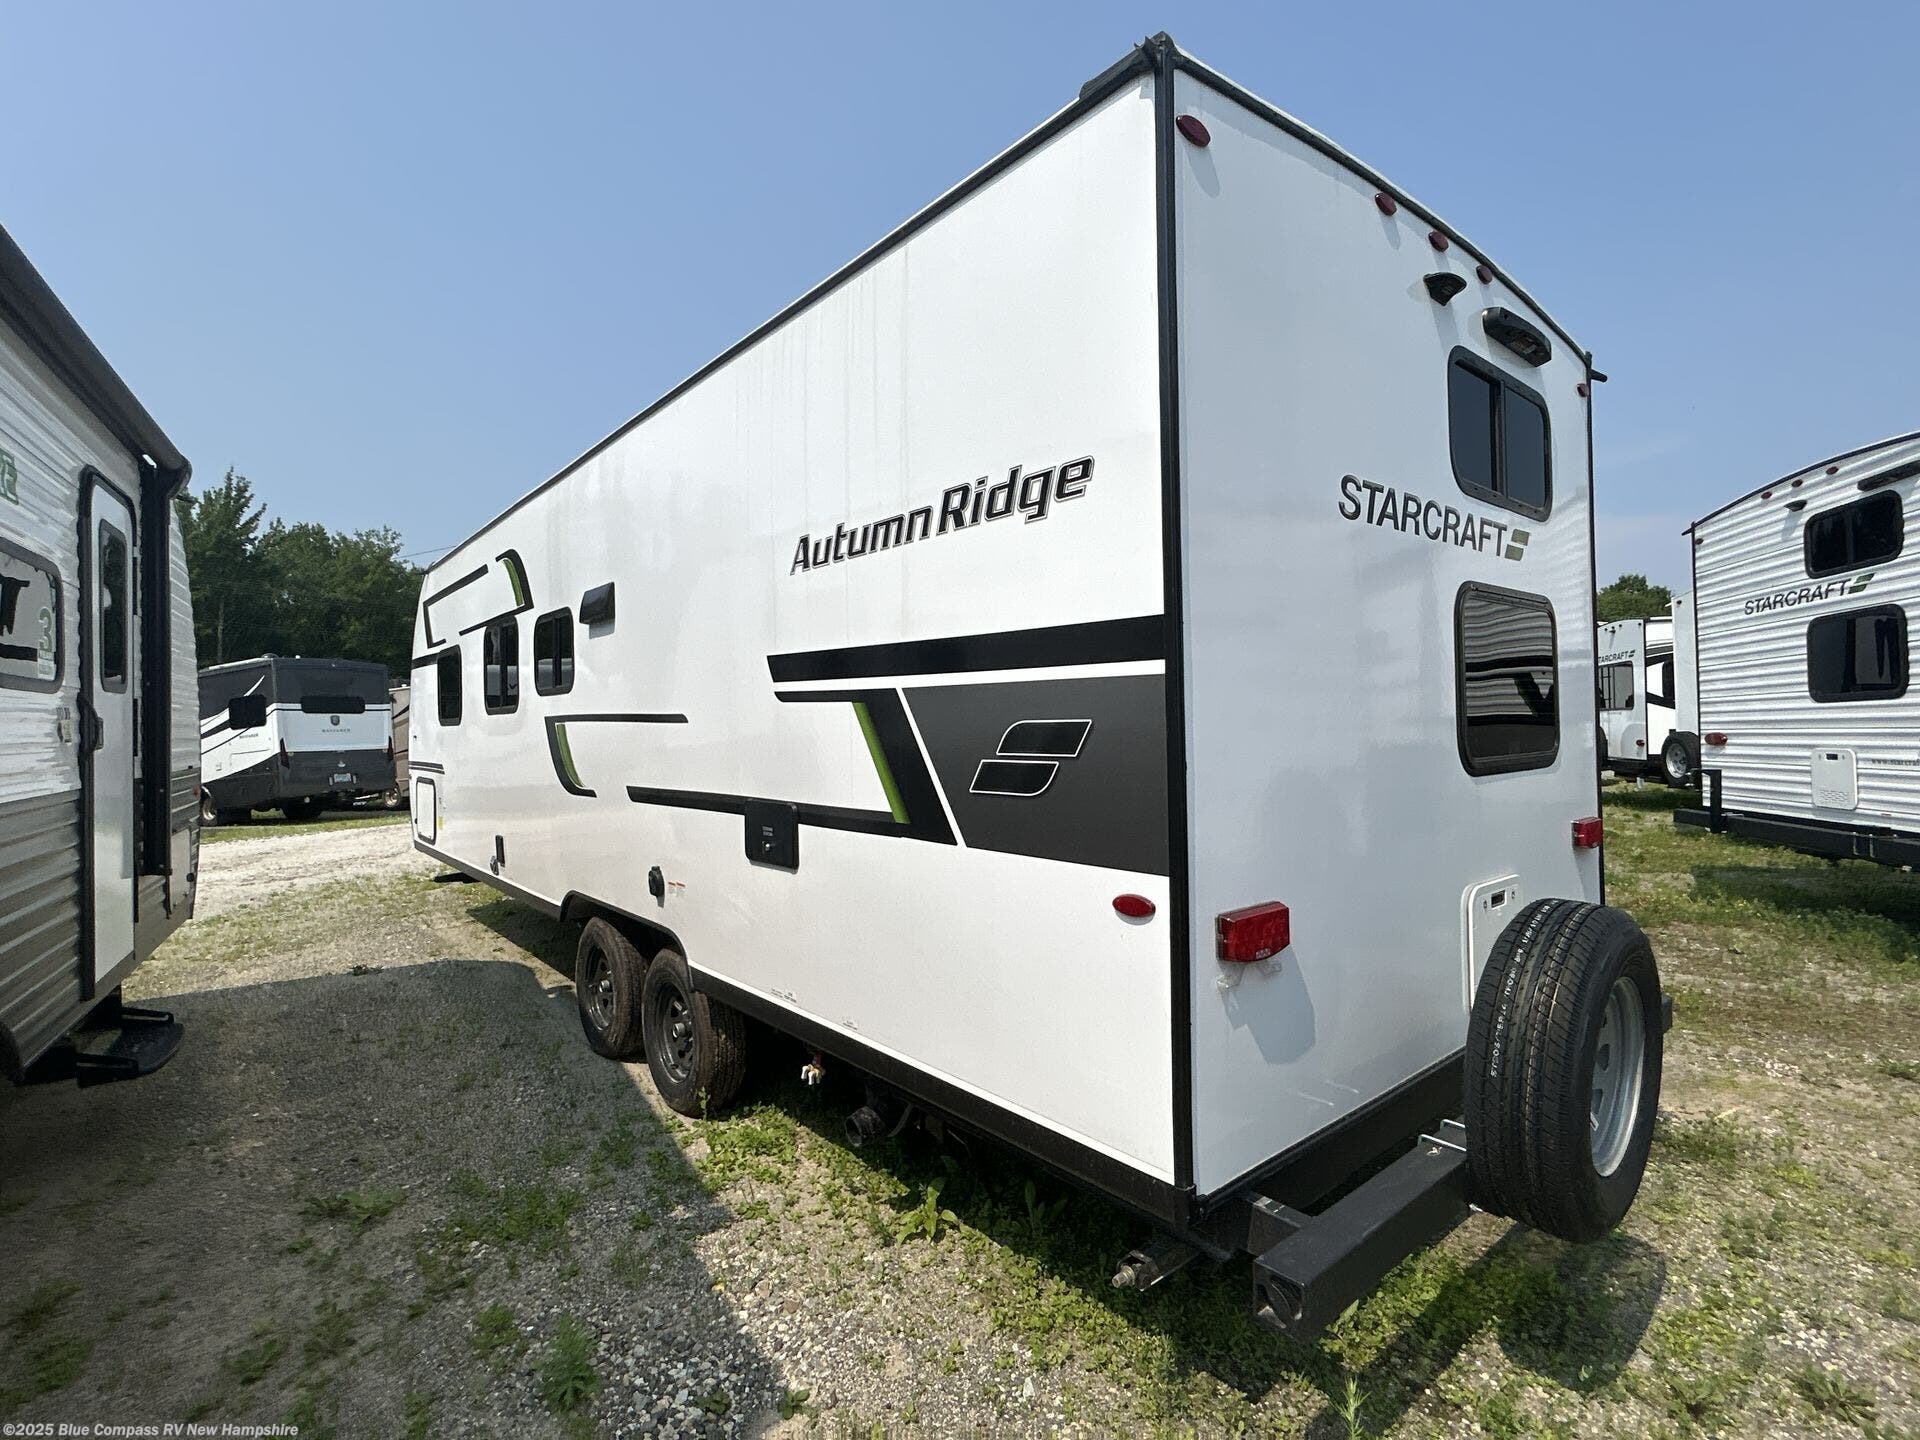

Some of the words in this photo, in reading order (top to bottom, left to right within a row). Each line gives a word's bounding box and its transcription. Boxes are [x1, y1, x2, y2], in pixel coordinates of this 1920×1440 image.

[1338, 474, 1508, 557] STARCRAFT
[1744, 578, 1852, 615] STARCRAFT
[1597, 650, 1629, 663] TARCRAFT
